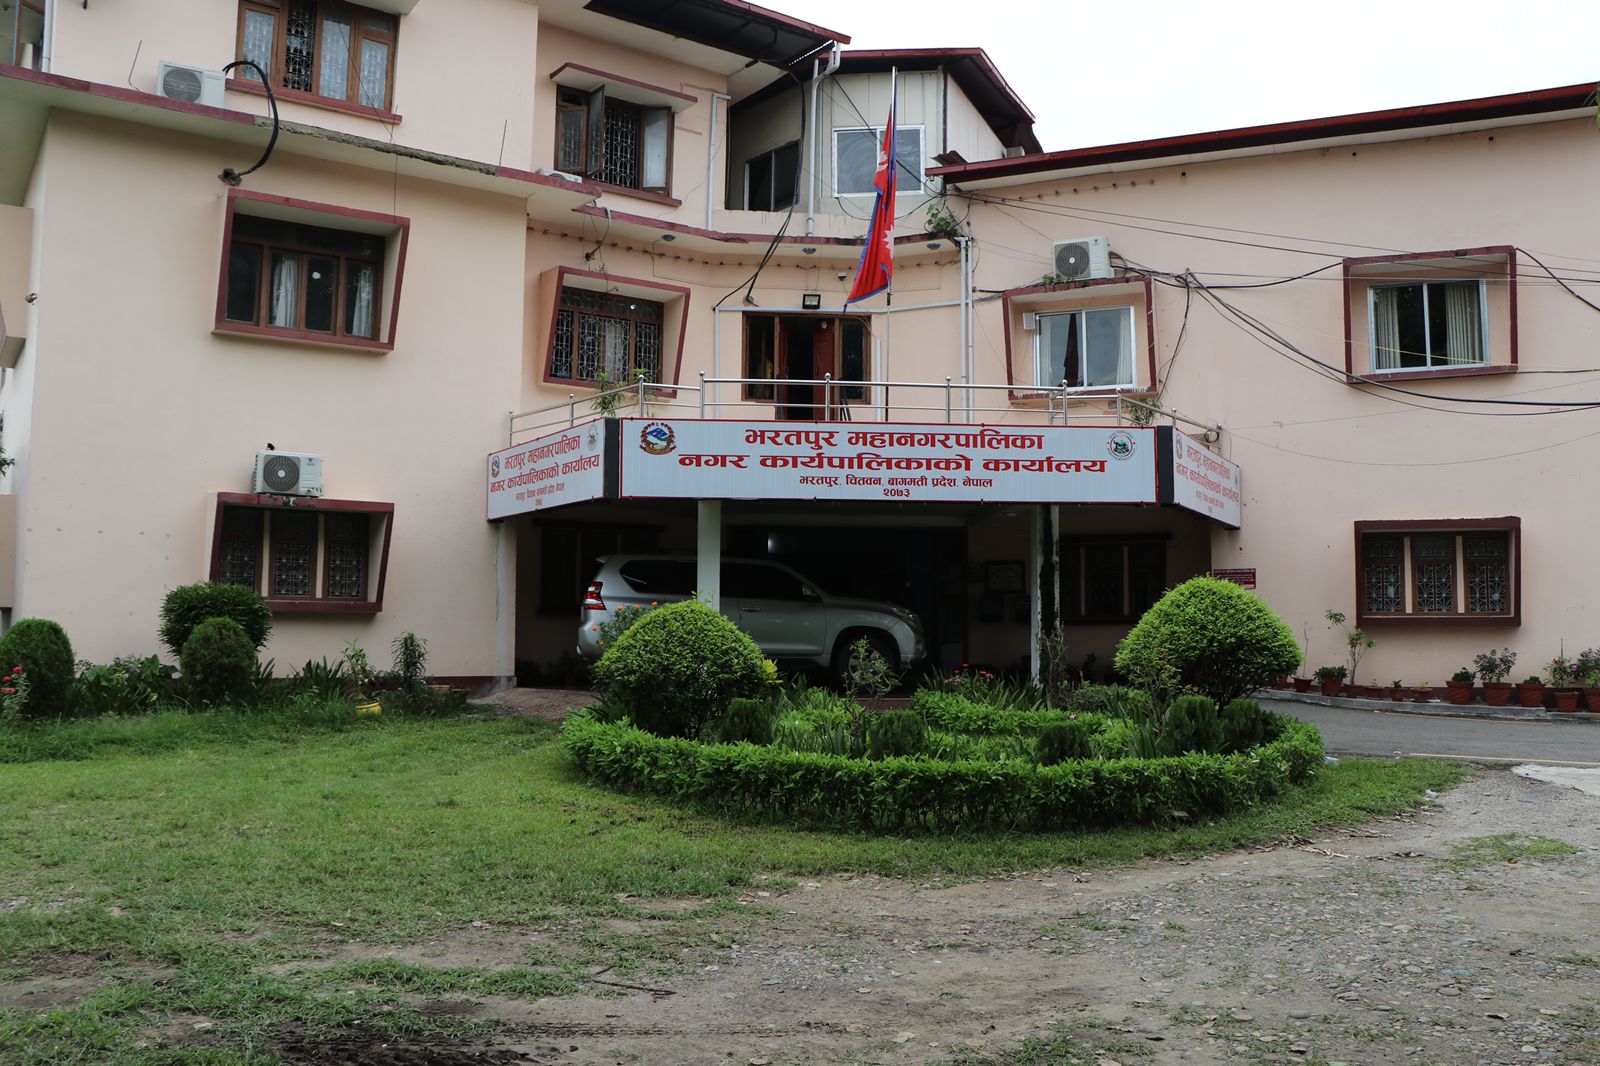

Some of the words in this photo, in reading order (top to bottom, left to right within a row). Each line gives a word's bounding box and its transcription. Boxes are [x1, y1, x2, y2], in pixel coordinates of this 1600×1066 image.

[744, 429, 839, 450] भरतपुर
[847, 428, 1044, 450] महानगरपालिका
[678, 453, 750, 469] नगर
[759, 452, 973, 473] कार्यपालिकाको
[982, 456, 1107, 473] कार्यालय
[887, 475, 928, 487] बागमती
[962, 476, 993, 488] नेपाल
[883, 488, 911, 498] २०७३
